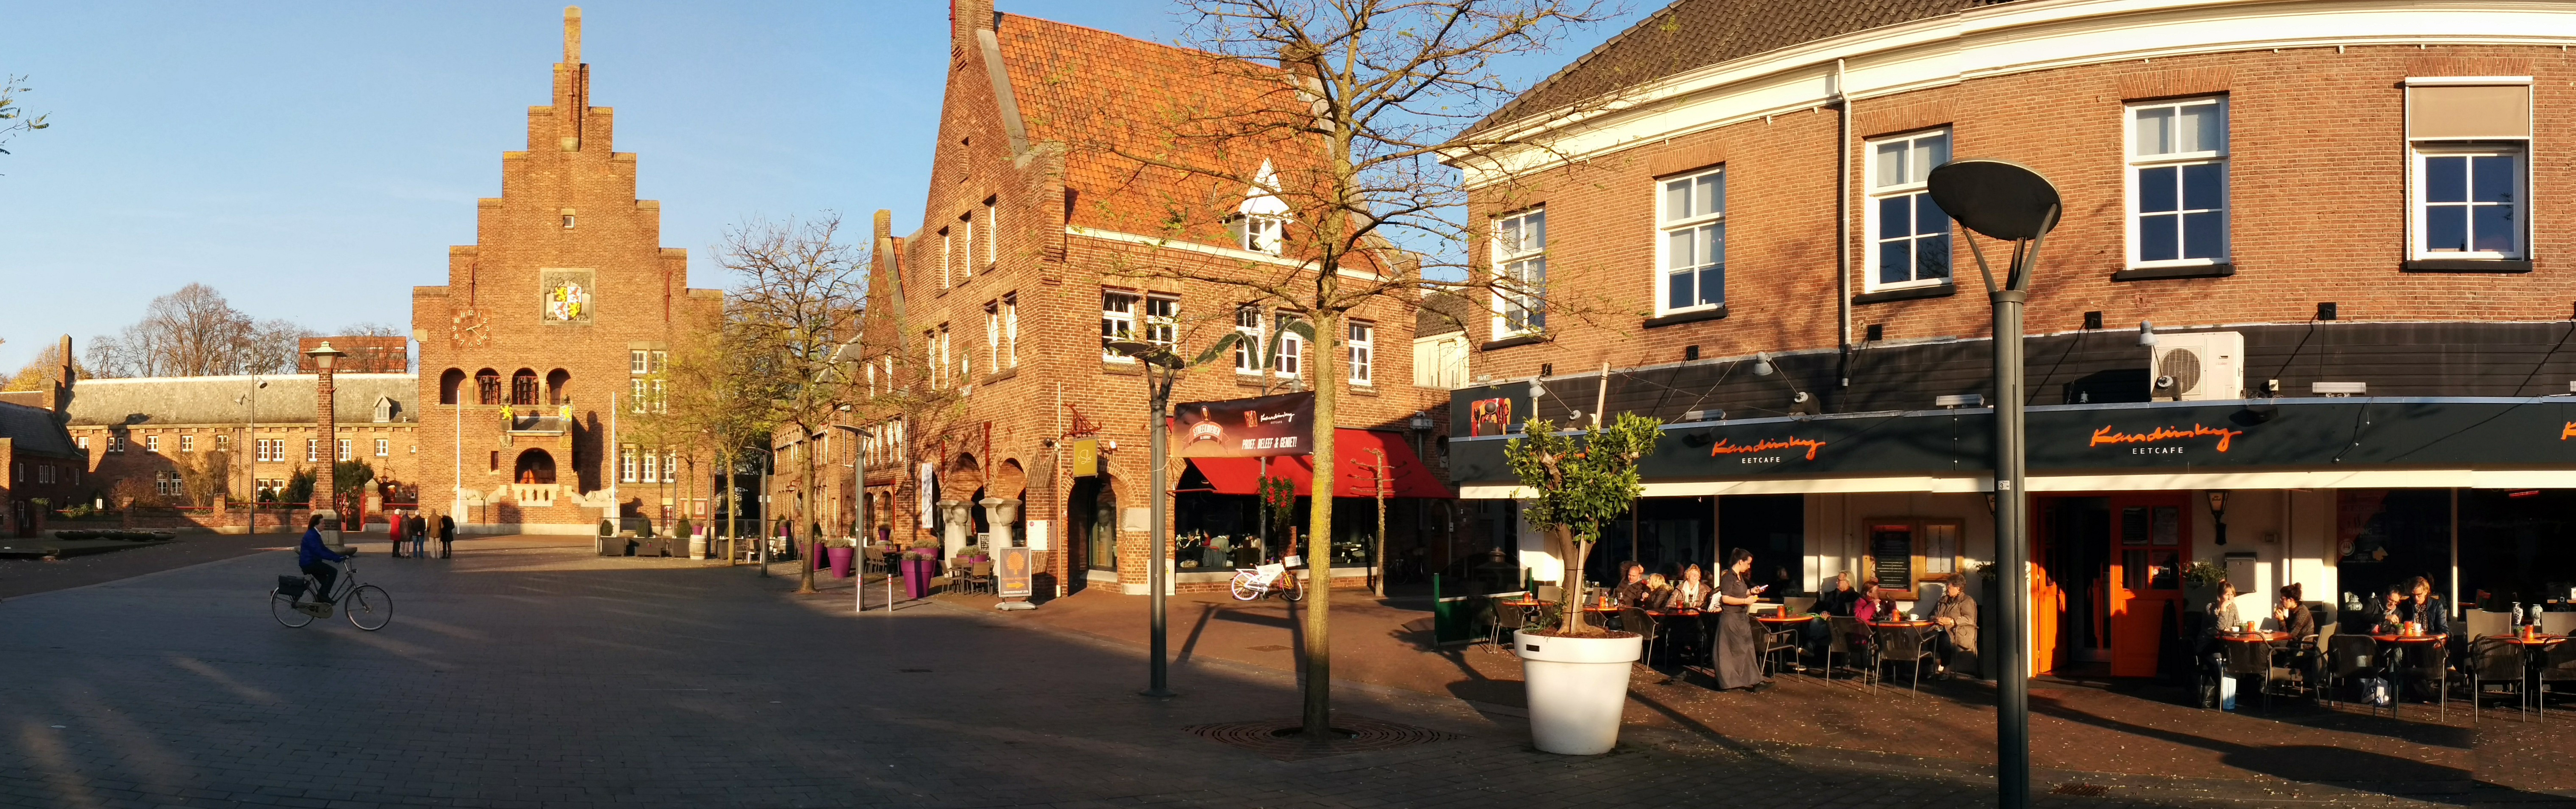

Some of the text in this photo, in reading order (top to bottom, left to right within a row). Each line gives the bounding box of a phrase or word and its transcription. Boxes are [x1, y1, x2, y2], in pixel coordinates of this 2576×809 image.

[962, 385, 972, 396] SLOT
[1261, 411, 1295, 422] Kandinsky
[1193, 424, 1221, 437] STREEKBIEREN
[1257, 437, 1274, 449] BELEEF
[1274, 437, 1279, 448] &
[1280, 436, 1298, 448] GENIET!
[2090, 423, 2242, 452] Kandinsky
[1711, 436, 1826, 461] Kandinsky
[1079, 449, 1092, 465] Slot
